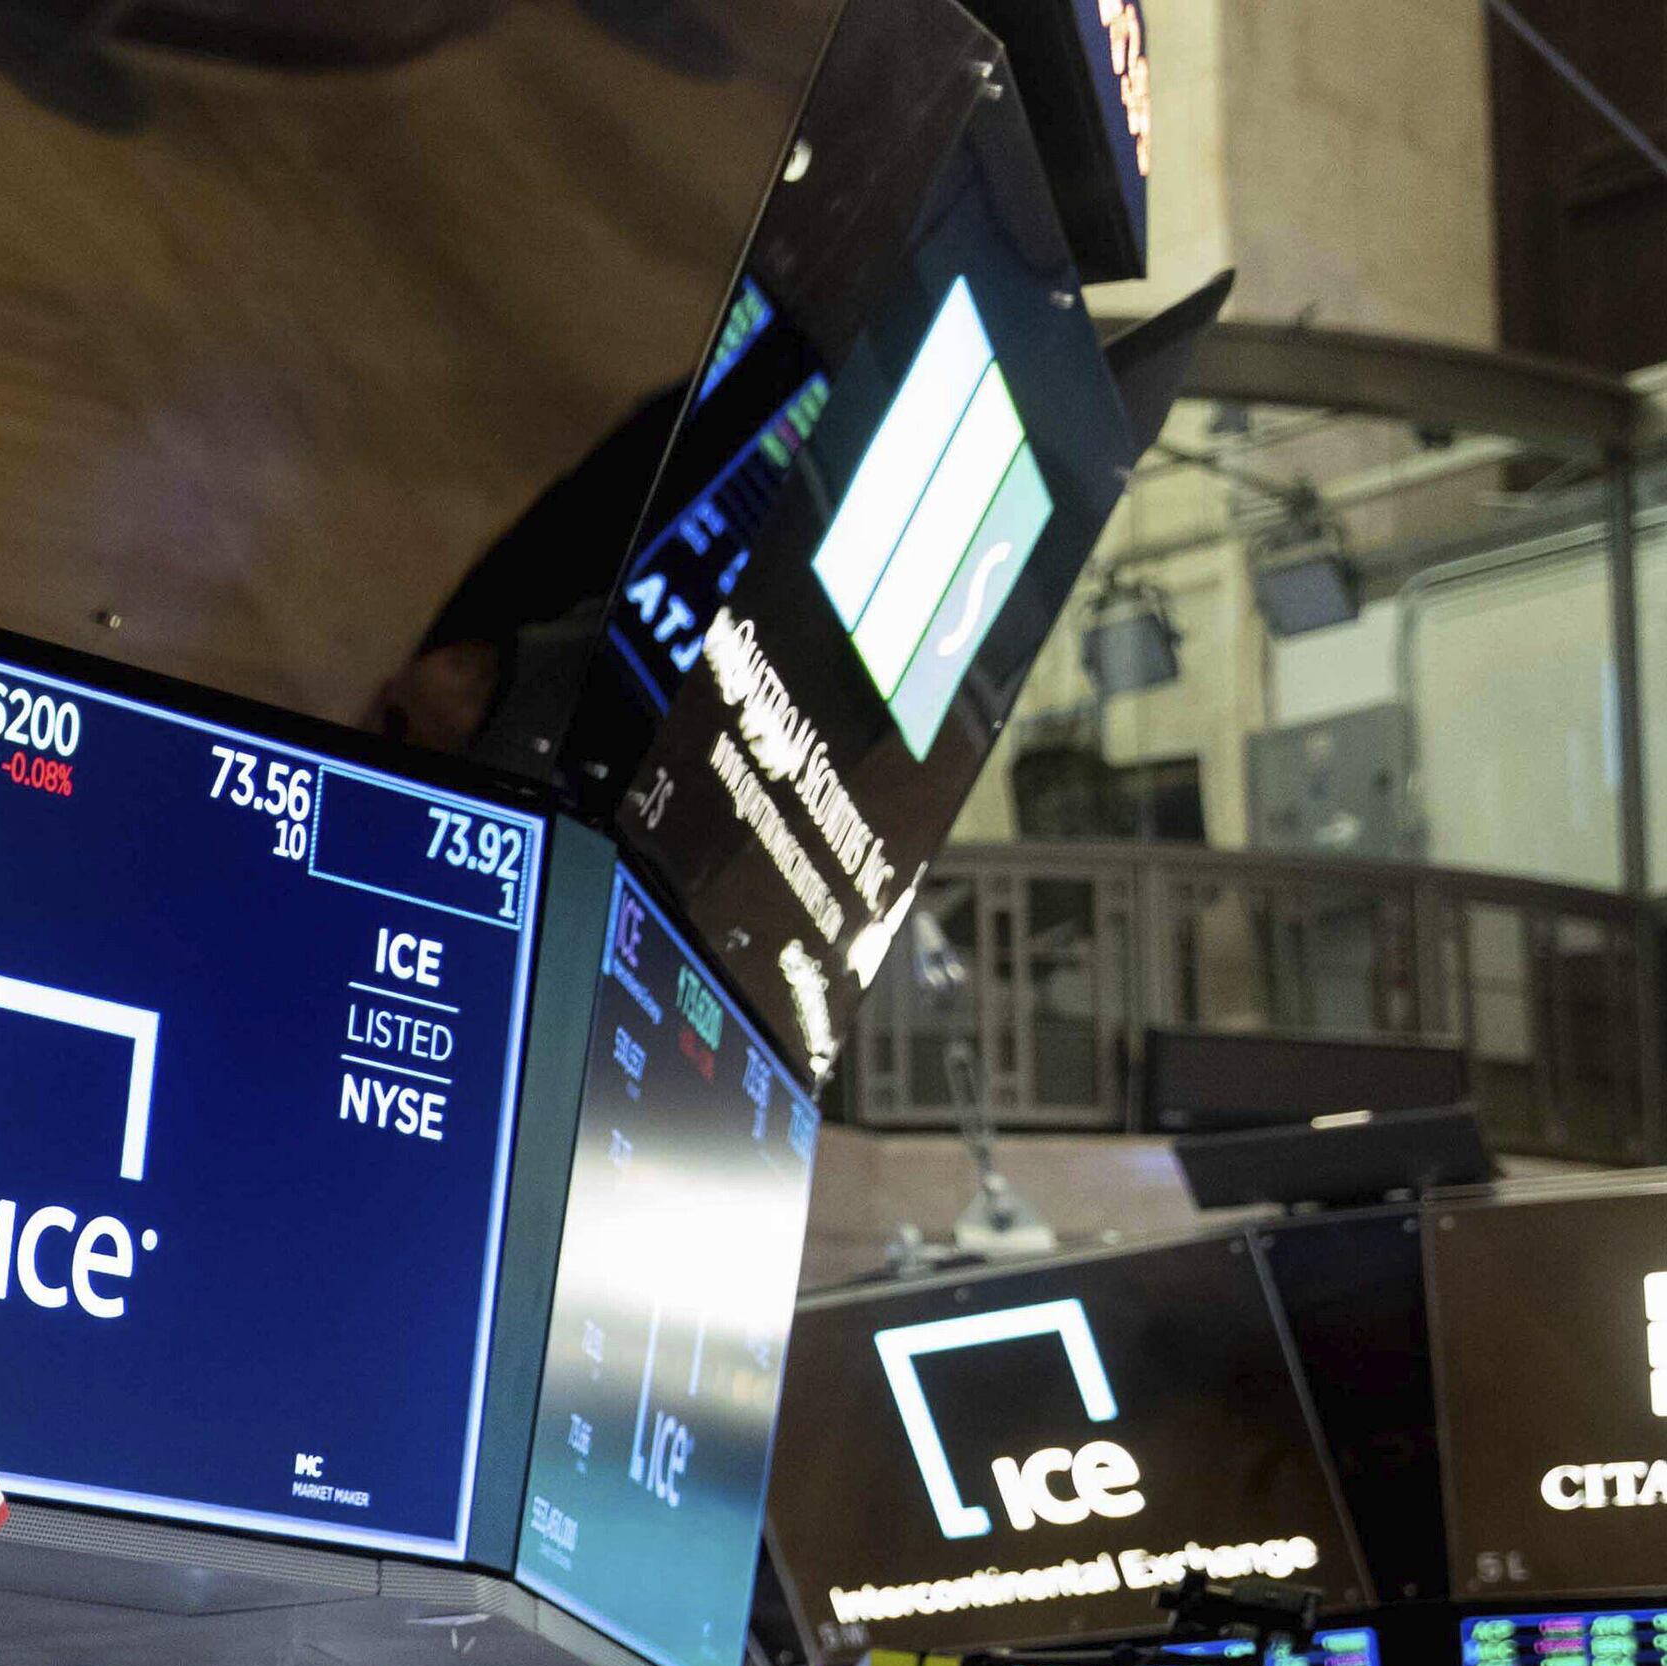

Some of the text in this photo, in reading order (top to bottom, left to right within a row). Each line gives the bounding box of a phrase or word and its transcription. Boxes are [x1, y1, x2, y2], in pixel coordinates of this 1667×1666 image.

[1, 751, 73, 797] -0.08%
[211, 745, 312, 823] 73.56
[272, 819, 307, 861] 10
[426, 807, 522, 883] 73.92
[498, 881, 516, 919] 1
[375, 927, 443, 988] ICE
[347, 1003, 453, 1062] LISTED
[339, 1072, 447, 1141] NYSE
[292, 1481, 370, 1508] MARKET MAKER
